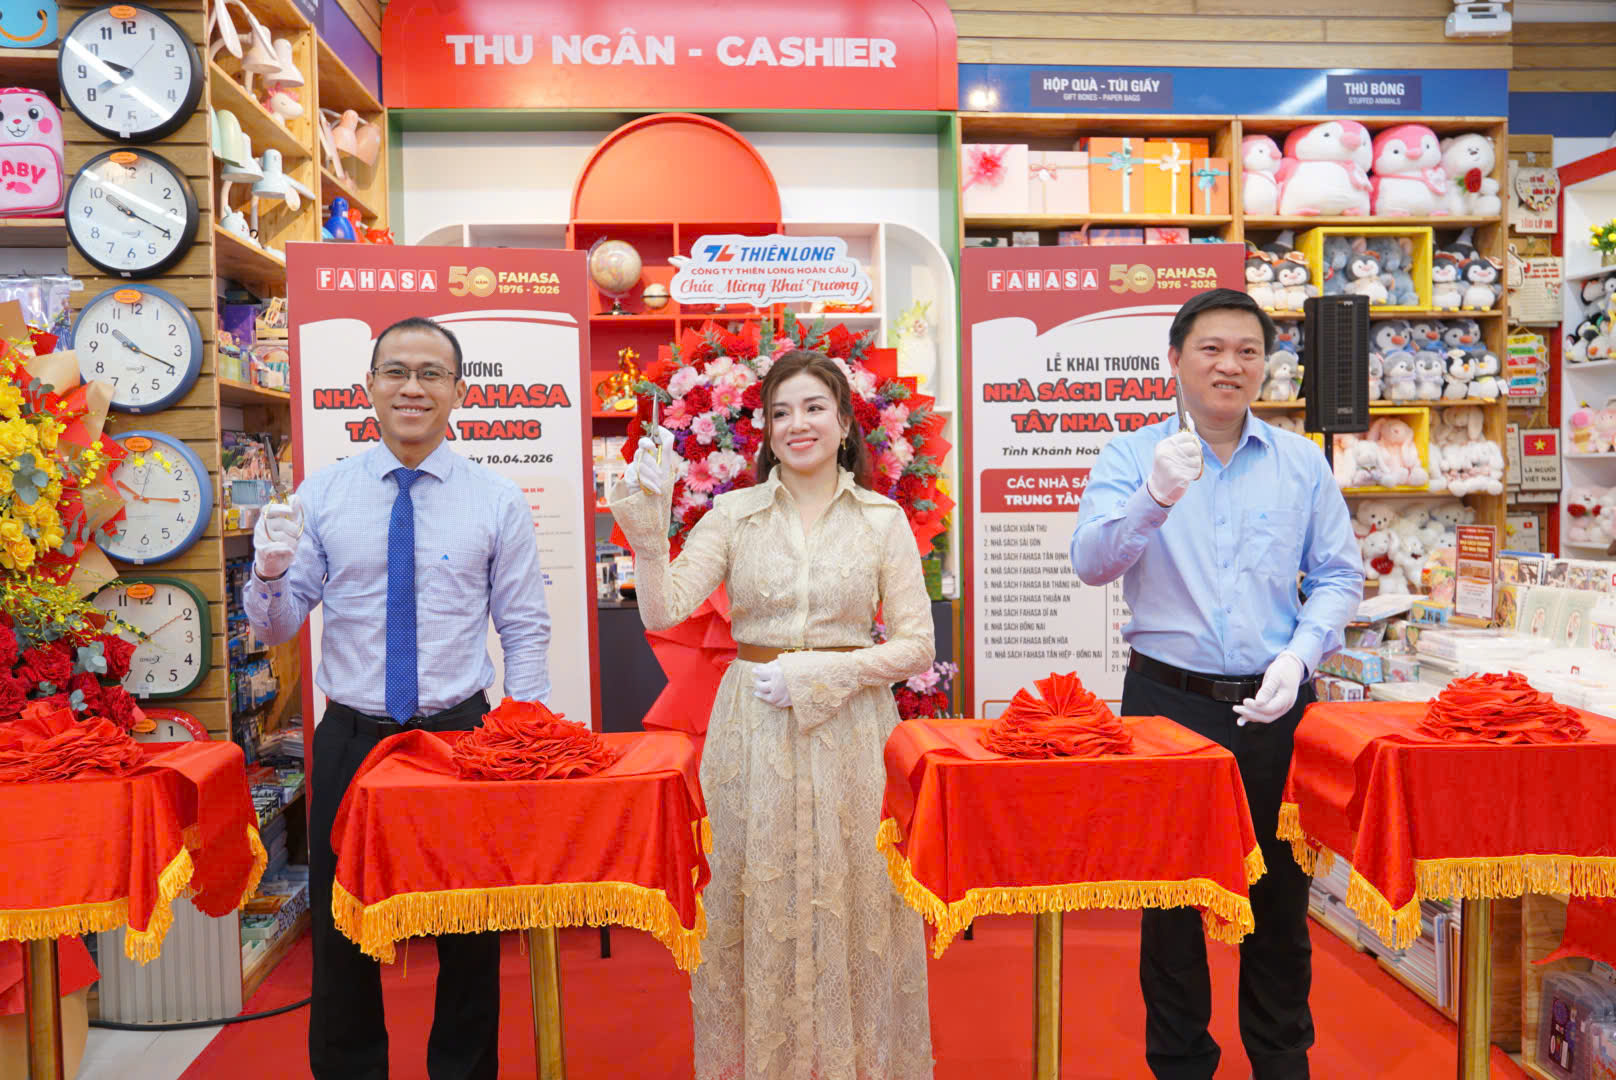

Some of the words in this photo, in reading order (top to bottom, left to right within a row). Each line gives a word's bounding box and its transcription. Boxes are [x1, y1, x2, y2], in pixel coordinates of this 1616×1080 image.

[100, 27, 112, 40] 11
[121, 21, 136, 34] 12
[446, 35, 533, 65] THU
[552, 27, 675, 65] NGÂN
[688, 48, 702, 56] -
[717, 36, 897, 68] CASHIER
[78, 65, 87, 78] 9
[1043, 77, 1069, 92] HỘP
[1072, 77, 1098, 92] QUÀ
[1108, 78, 1128, 92] TÚI
[1131, 77, 1160, 92] GIẤY
[1344, 81, 1368, 96] THÚ
[1370, 81, 1405, 96] BÔNG
[87, 88, 96, 102] 8
[1, 160, 46, 184] ABY
[90, 187, 103, 199] 10
[163, 188, 172, 200] 2
[147, 243, 156, 254] 5
[740, 244, 836, 262] THIÊNLONG
[691, 266, 720, 276] CÔNG
[736, 266, 765, 274] THIÊN
[797, 265, 826, 274] HOÀN
[1157, 267, 1218, 278] FAHASA
[319, 269, 436, 290] FAHASA
[448, 266, 496, 298] 50
[498, 272, 560, 284] FAHASA
[990, 270, 1097, 290] FAHASA
[1109, 264, 1156, 294] 50
[1157, 280, 1182, 288] 1976
[1190, 280, 1217, 288] 2026
[498, 285, 523, 294] 1976
[533, 286, 560, 294] 2026
[680, 279, 713, 294] Chúc
[727, 279, 766, 299] Mừng
[770, 278, 804, 292] Khai
[807, 279, 859, 296] Trương
[131, 303, 143, 315] 12
[96, 322, 109, 334] 10
[168, 324, 176, 336] 2
[89, 341, 98, 352] 9
[1046, 352, 1062, 372] LỄ
[1067, 357, 1100, 372] KHAI
[1104, 354, 1160, 372] TRƯƠNG
[463, 360, 503, 377] ƯƠNG
[152, 378, 160, 390] 5
[983, 378, 1036, 402] NHÀ
[1037, 378, 1102, 402] SÁCH
[1105, 377, 1177, 402] FAHA
[313, 384, 372, 410] NHÀ
[462, 384, 572, 408] AHASA
[1011, 409, 1059, 433] TÂY
[1060, 413, 1114, 432] NHA
[1114, 412, 1176, 432] TRA
[345, 417, 382, 442] TÂ
[457, 420, 542, 441] TRANG
[1002, 446, 1028, 456] Tỉnh
[1032, 446, 1072, 456] Khánh
[487, 454, 553, 464] 10.04.2026
[1007, 475, 1035, 488] CÁC
[1038, 475, 1068, 488] NHÀ
[1072, 475, 1090, 488] SÁ
[182, 490, 191, 502] 3
[1004, 494, 1052, 506] TRUNG
[140, 534, 150, 546] 6
[162, 528, 170, 540] 5
[1020, 552, 1041, 560] FAHASA
[1020, 566, 1041, 574] FAHASA
[1020, 580, 1041, 588] FAHASA
[1020, 594, 1041, 602] FAHASA
[183, 608, 192, 620] 2
[1020, 608, 1041, 616] FAHASA
[1020, 636, 1041, 644] FAHASA
[184, 653, 193, 666] 4
[1024, 650, 1045, 658] FAHASA
[145, 669, 155, 683] 6
[168, 670, 178, 682] 5
